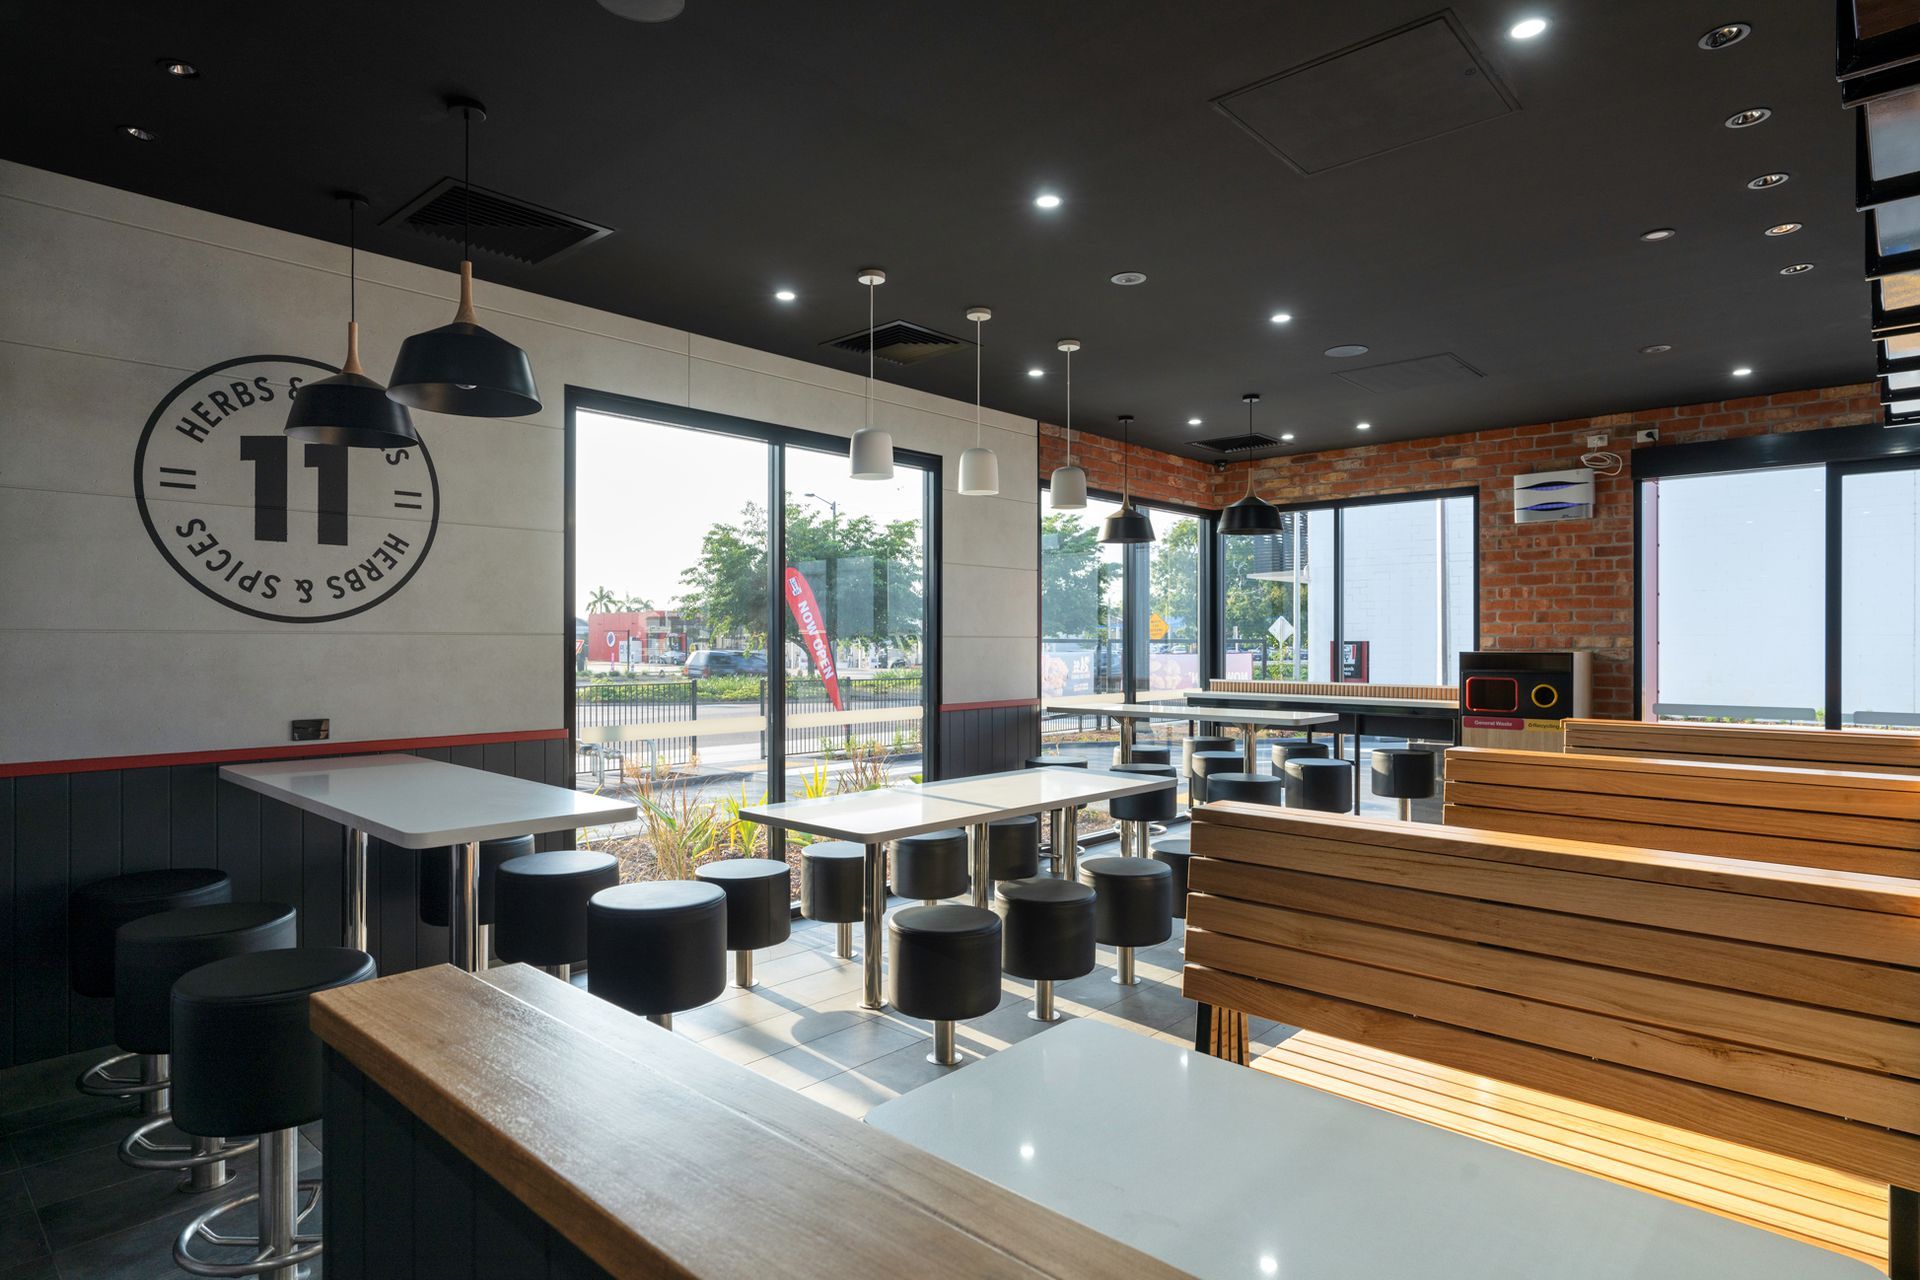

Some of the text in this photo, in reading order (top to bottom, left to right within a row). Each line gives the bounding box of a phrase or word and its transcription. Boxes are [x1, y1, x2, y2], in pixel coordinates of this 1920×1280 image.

[175, 376, 275, 443] HERBS
[240, 435, 348, 546] 11
[175, 518, 410, 603] HERBS & SPICES
[798, 600, 834, 680] NOW OPEN
